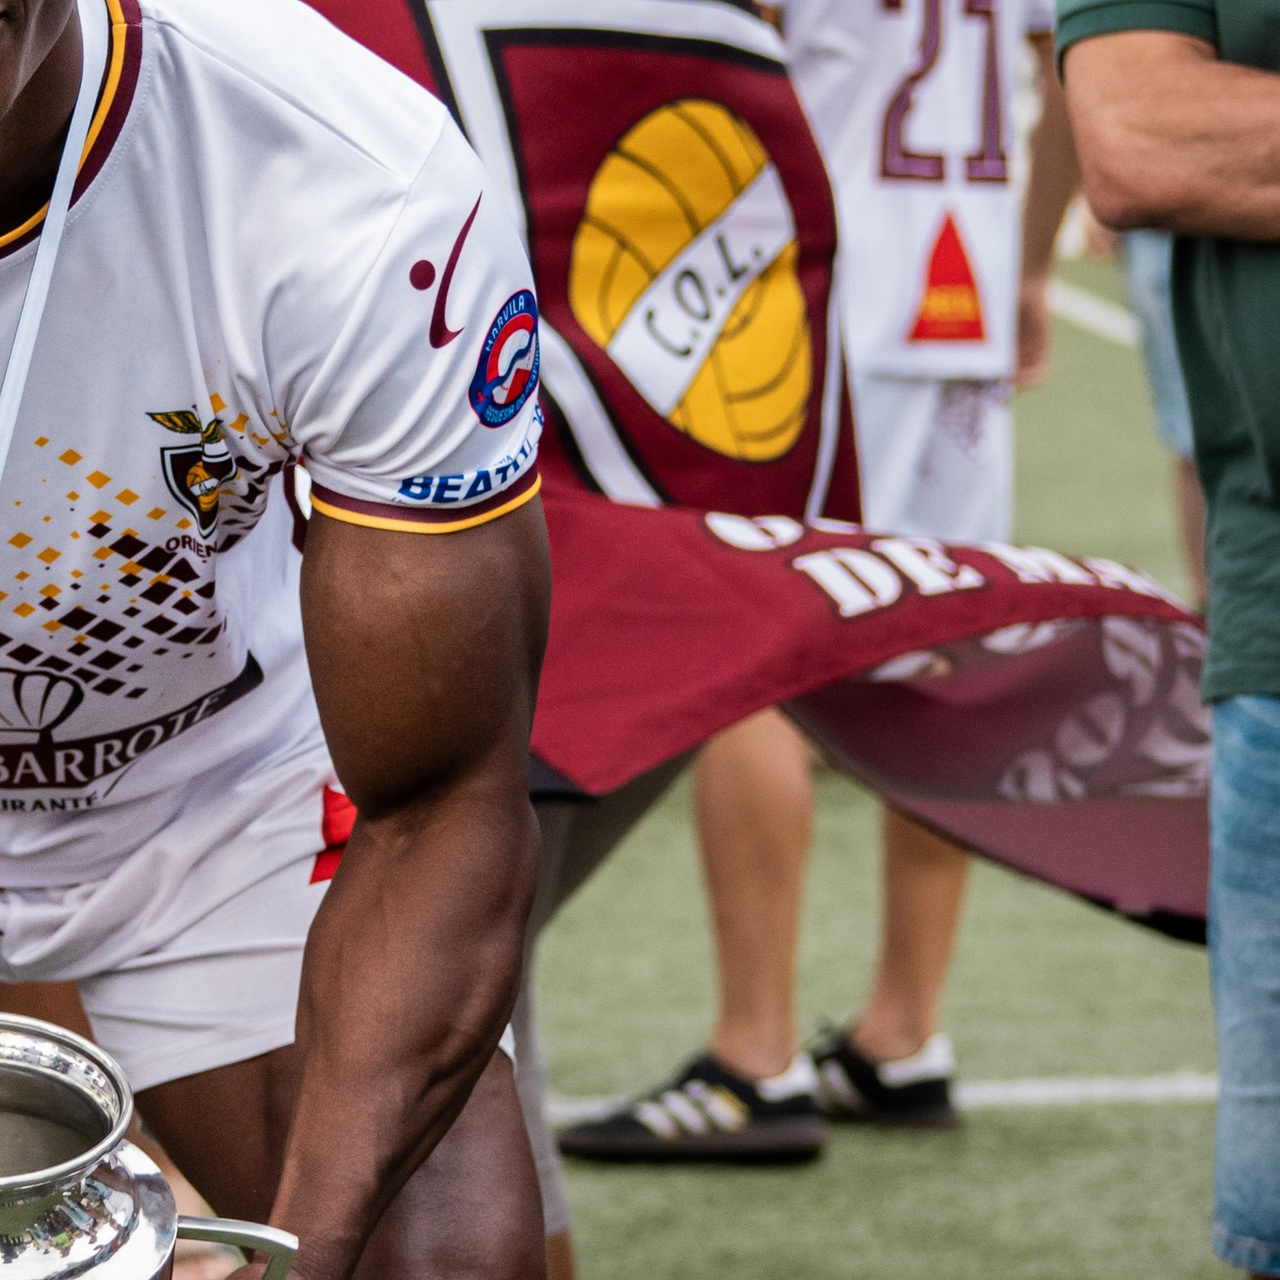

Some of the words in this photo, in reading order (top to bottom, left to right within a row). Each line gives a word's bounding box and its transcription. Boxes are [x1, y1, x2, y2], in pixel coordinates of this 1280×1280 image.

[484, 294, 526, 353] MARVILA
[645, 232, 764, 358] C.O.L.
[792, 537, 986, 617] DE
